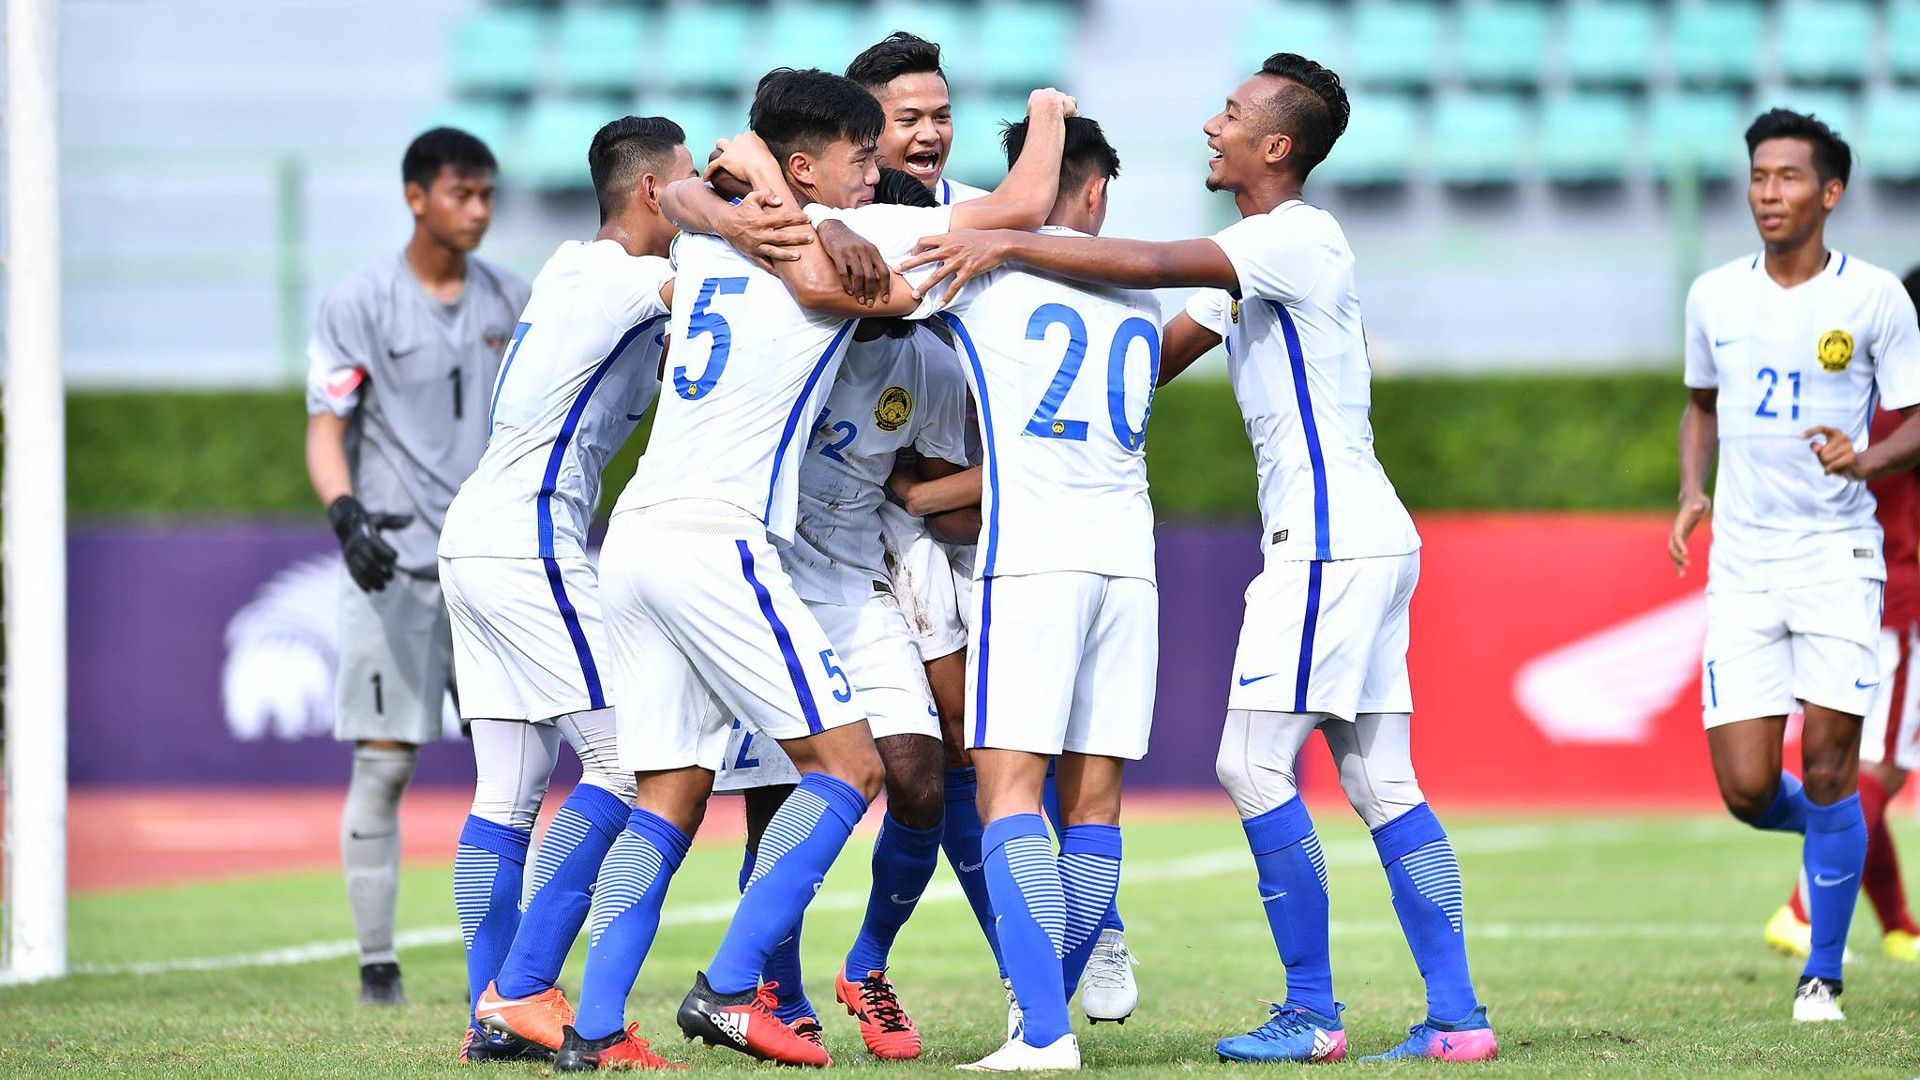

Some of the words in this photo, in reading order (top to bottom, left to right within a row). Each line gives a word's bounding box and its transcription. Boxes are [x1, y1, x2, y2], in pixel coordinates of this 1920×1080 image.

[673, 276, 749, 400] 5
[447, 365, 463, 420] 1
[1021, 302, 1161, 451] 20
[1755, 367, 1801, 421] 21
[370, 672, 384, 715] 1
[818, 648, 851, 703] 5
[710, 1013, 748, 1047] adidas
